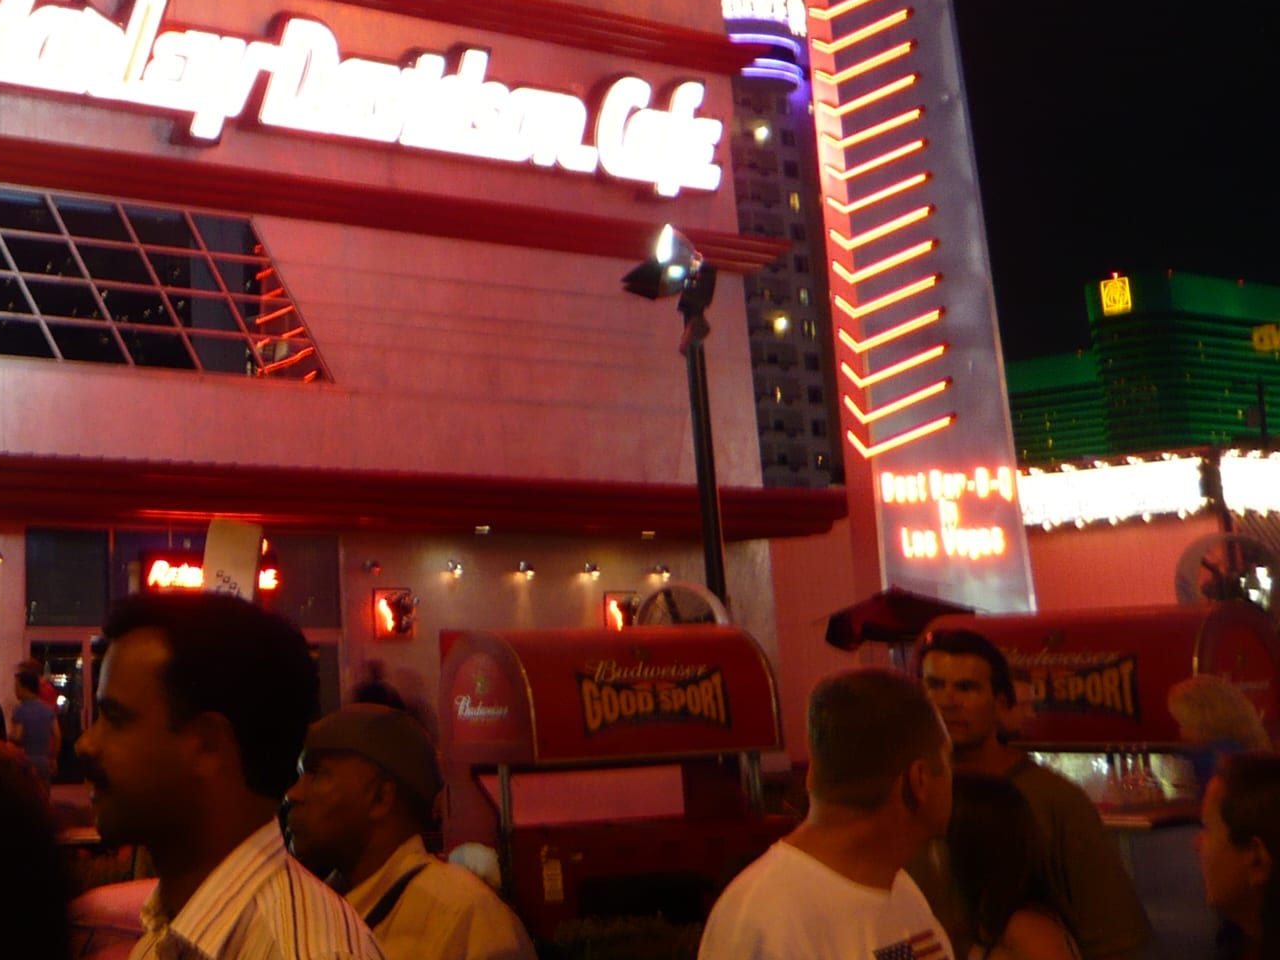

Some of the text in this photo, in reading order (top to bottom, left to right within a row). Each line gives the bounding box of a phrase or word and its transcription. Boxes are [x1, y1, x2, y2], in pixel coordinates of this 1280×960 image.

[586, 659, 707, 683] Budweiser
[1053, 658, 1136, 717] SPORT
[581, 671, 726, 731] GOOD SPORT
